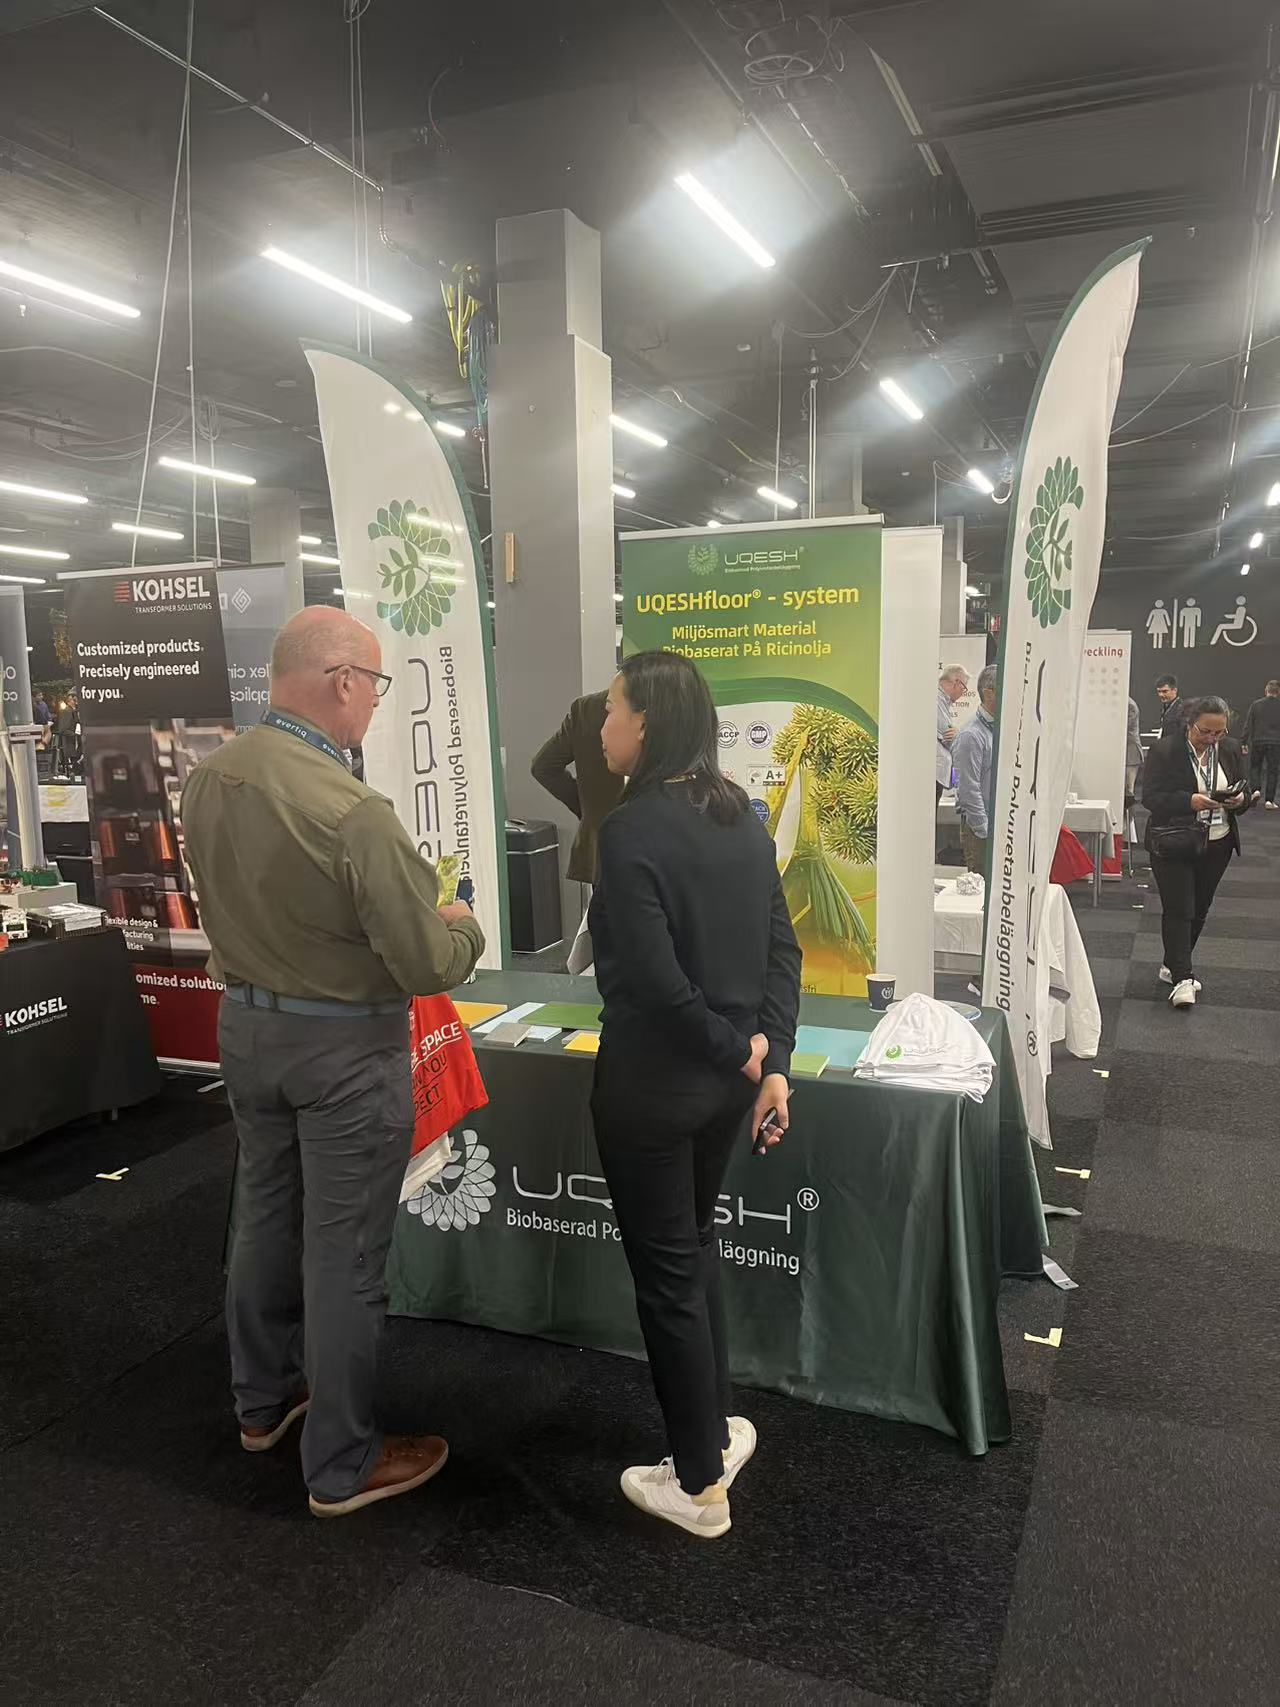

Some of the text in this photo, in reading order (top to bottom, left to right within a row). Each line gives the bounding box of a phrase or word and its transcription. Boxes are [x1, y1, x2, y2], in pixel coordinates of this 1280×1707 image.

[132, 576, 210, 601] KOHSEL
[135, 602, 213, 614] TRANSFORMER SOLUTIONS
[637, 589, 762, 615] UQESHfloor®
[783, 587, 859, 610] system
[672, 621, 817, 642] Miljösmart Material
[77, 639, 204, 657] Customized products.
[743, 641, 761, 657] På
[766, 640, 832, 656] Ricinolja
[79, 661, 200, 680] Precisely engineered
[81, 686, 124, 702] for you.
[276, 718, 307, 739] evertiq
[751, 730, 768, 739] GMP
[765, 770, 783, 780] A+
[129, 918, 153, 929] design
[152, 919, 159, 928] &
[122, 929, 154, 942] facturing
[126, 941, 145, 951] lities
[135, 972, 178, 987] omized
[4, 996, 68, 1028] KOHSEL
[420, 1021, 461, 1056] SPACE
[506, 1207, 597, 1239] Biobaserad
[718, 1238, 800, 1276] läggning
